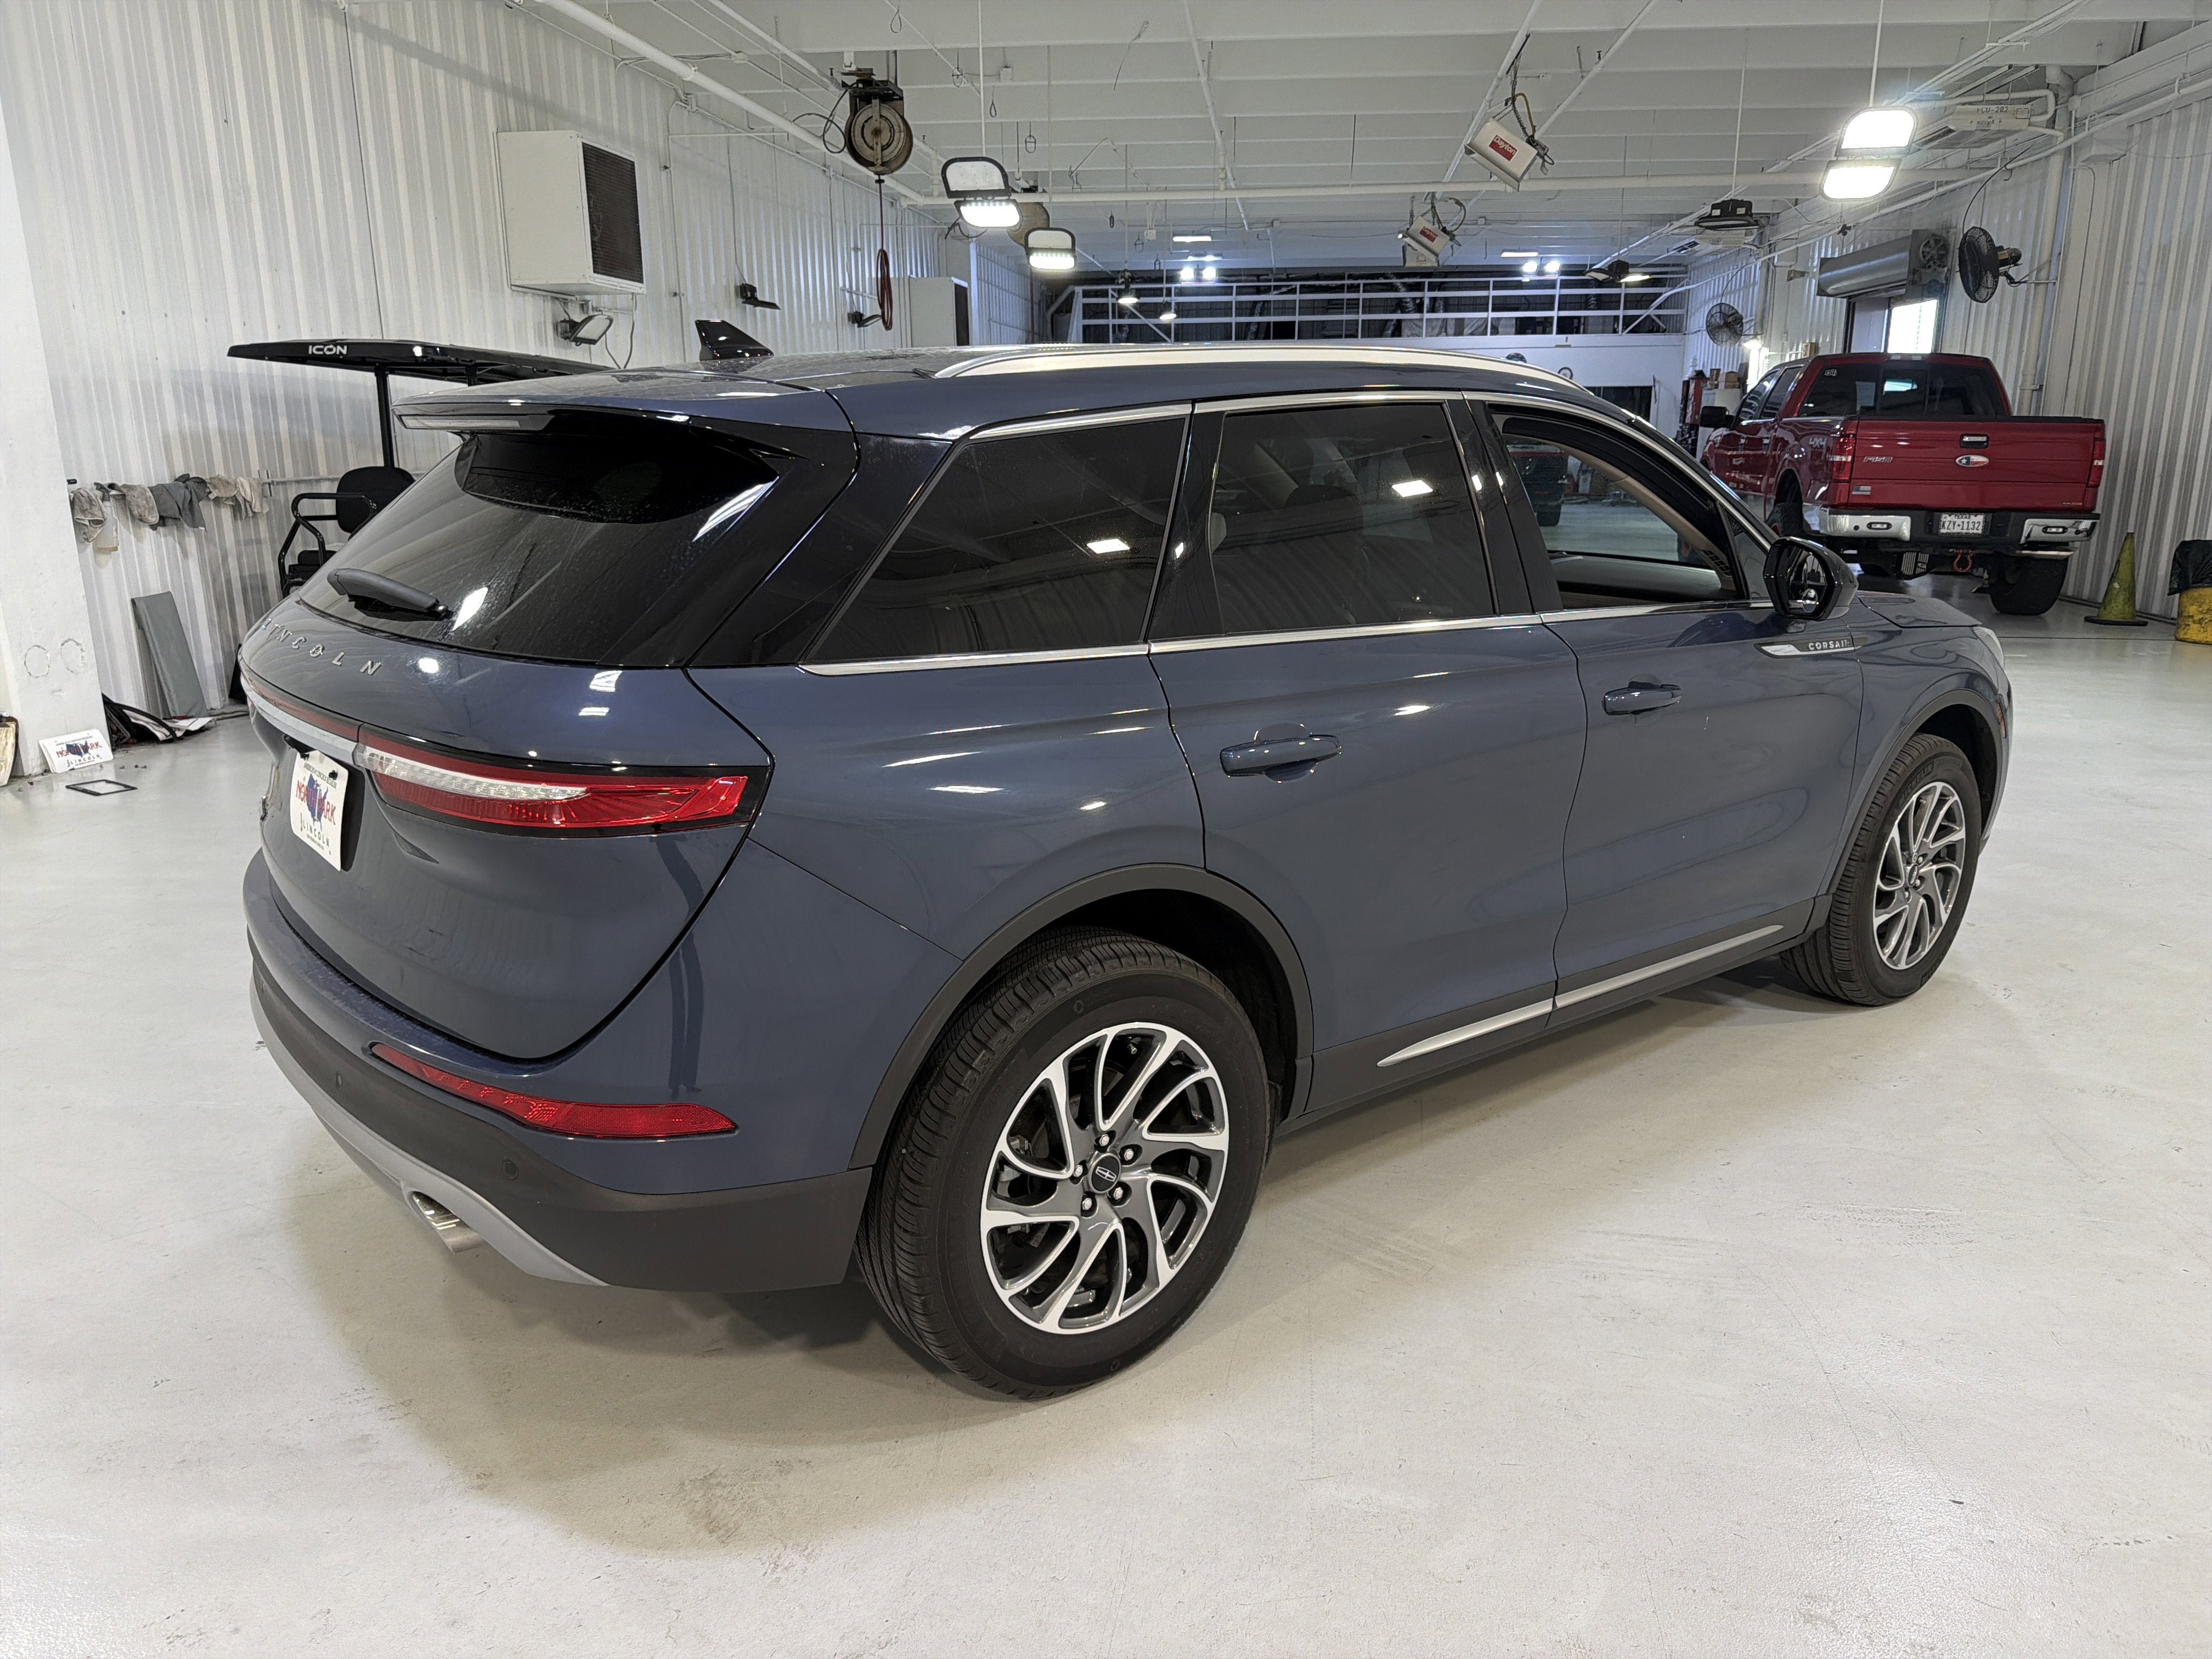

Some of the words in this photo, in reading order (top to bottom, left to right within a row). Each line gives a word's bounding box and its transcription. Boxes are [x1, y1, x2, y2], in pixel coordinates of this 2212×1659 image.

[1493, 136, 1516, 155] Dayton
[308, 344, 347, 355] ICON
[261, 618, 383, 675] LINCOLN
[70, 754, 100, 765] LINCOLN
[303, 819, 330, 848] LINCOLN
